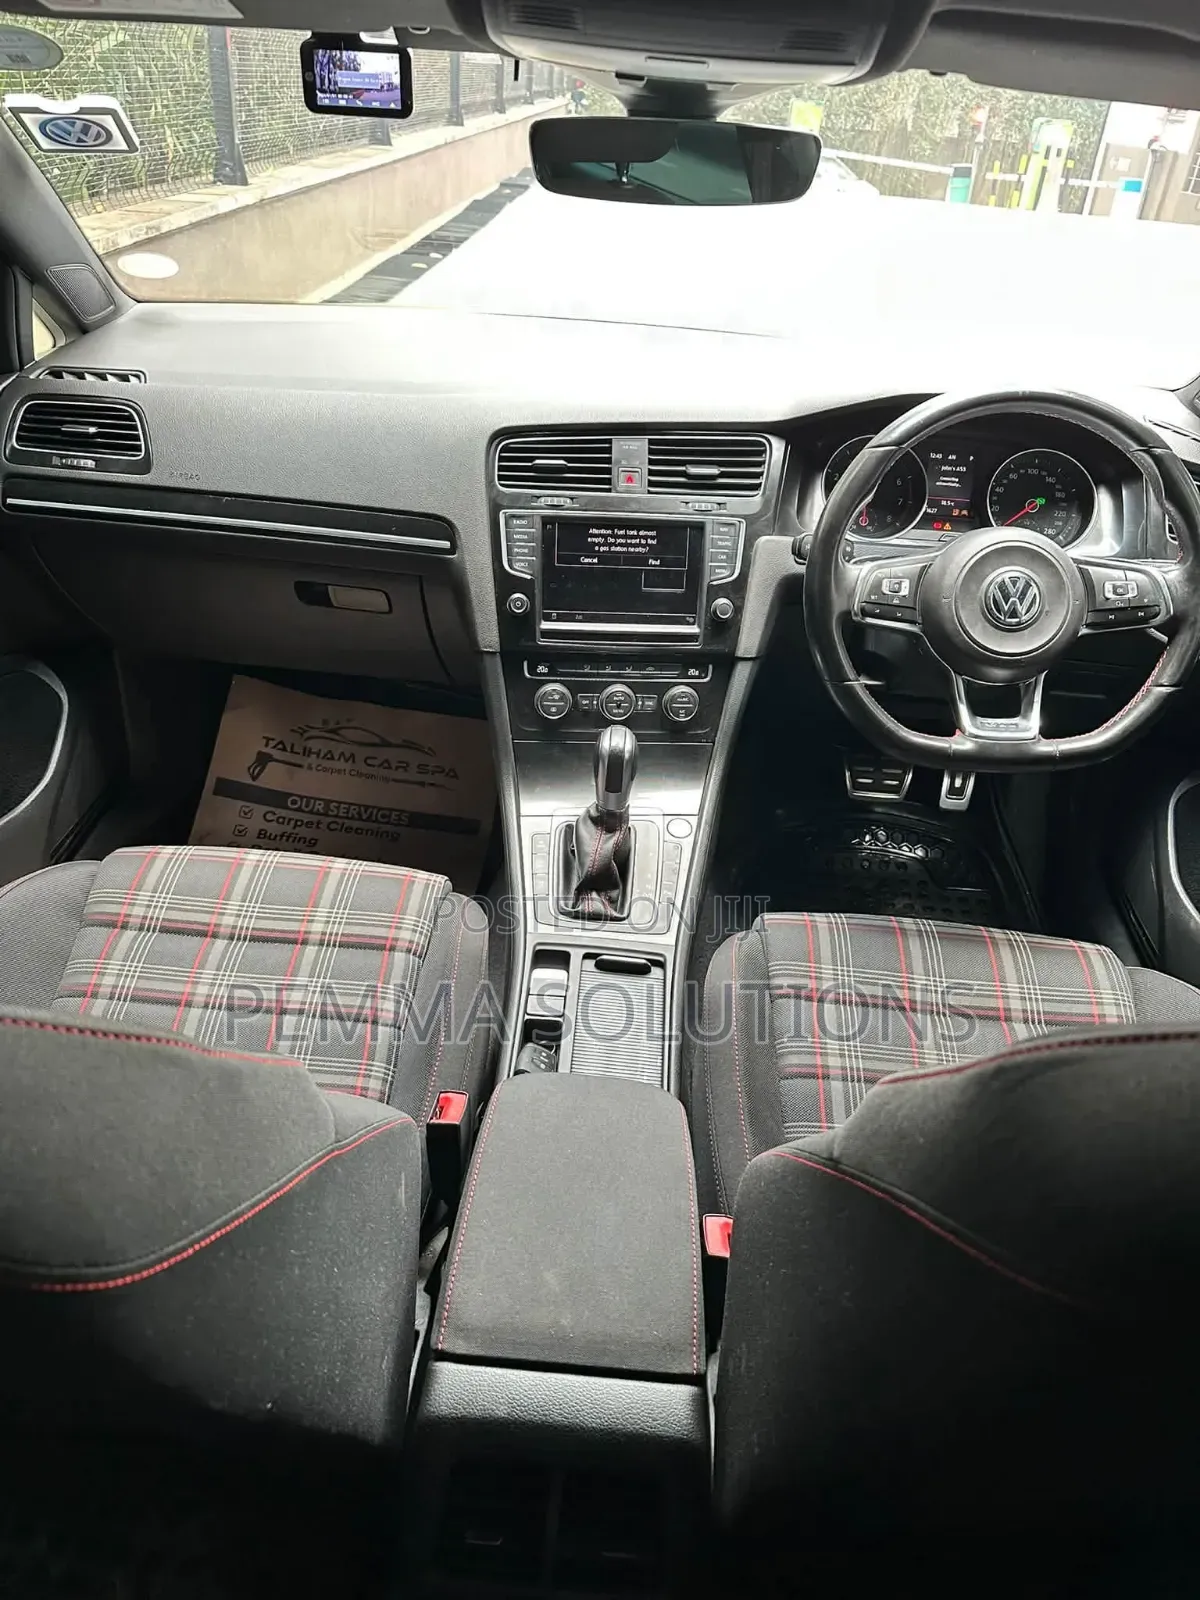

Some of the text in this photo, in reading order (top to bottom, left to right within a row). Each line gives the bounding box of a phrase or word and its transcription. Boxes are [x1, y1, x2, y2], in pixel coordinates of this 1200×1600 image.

[1045, 476, 1056, 484] 140
[580, 556, 598, 564] Cancel
[262, 735, 460, 780] TALIHAM CAR SPA
[315, 763, 347, 777] Carpet
[349, 768, 391, 785] Cleaning
[287, 795, 410, 826] OUR SERVICES
[263, 809, 401, 842] Carpet Cleaning
[256, 828, 319, 848] Buffing
